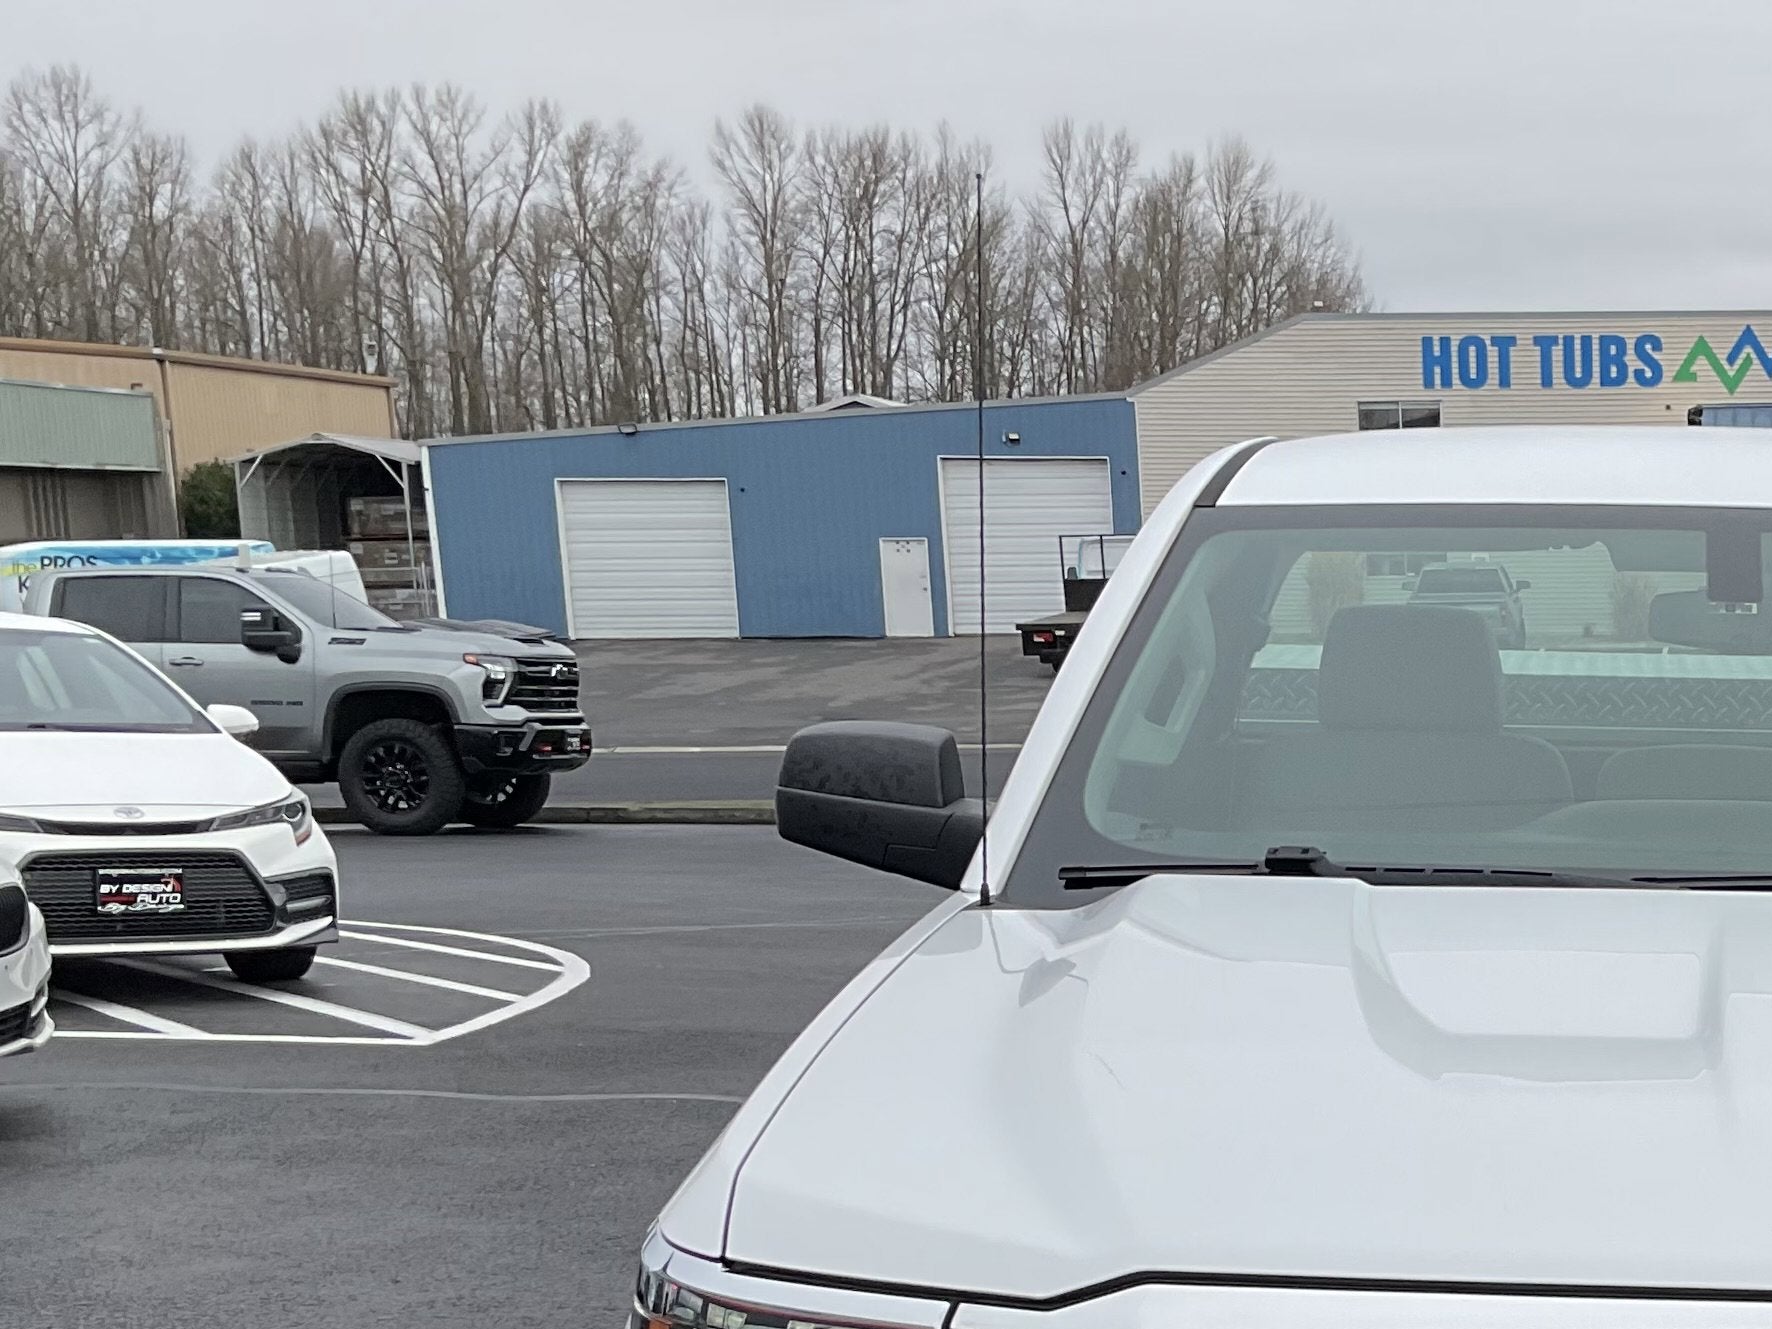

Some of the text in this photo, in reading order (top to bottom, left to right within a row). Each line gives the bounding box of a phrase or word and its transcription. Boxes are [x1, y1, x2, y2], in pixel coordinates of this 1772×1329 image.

[1421, 335, 1517, 390] HOT
[1533, 334, 1664, 389] TUBS
[100, 883, 173, 893] BY DESIGN
[137, 893, 181, 903] AUTO
